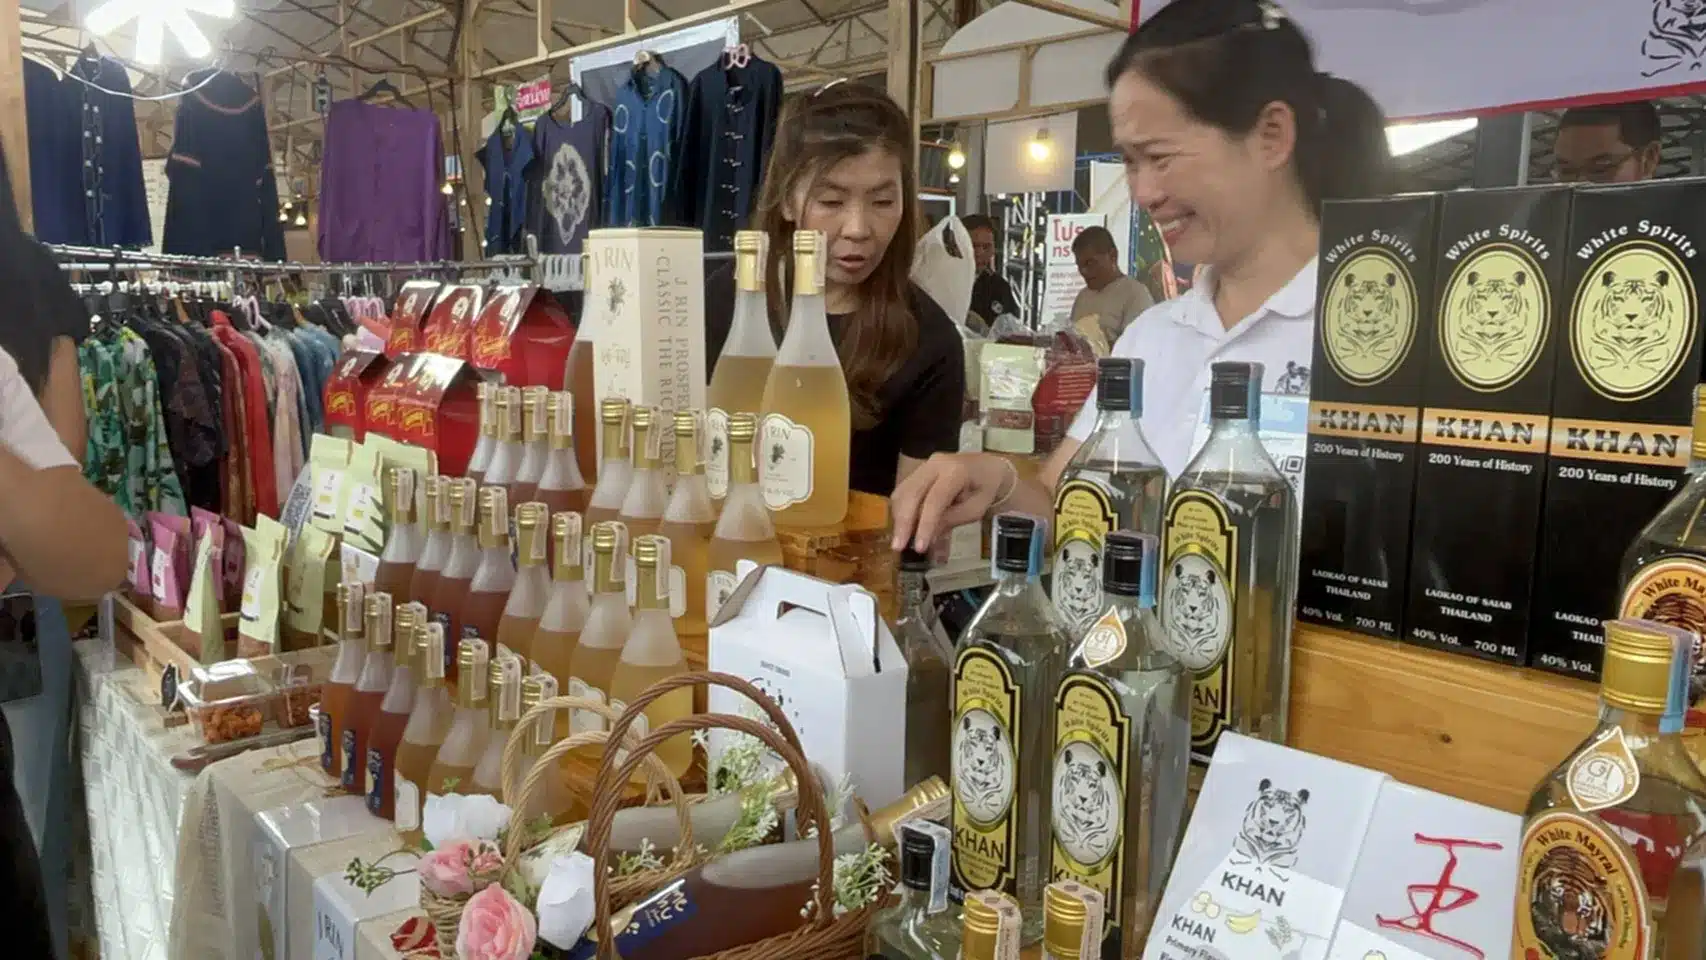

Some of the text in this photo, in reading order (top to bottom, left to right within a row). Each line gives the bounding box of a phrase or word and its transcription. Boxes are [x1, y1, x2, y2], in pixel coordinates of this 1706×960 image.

[1325, 229, 1417, 265] White Spirits
[1445, 224, 1550, 262] White Spirits
[1577, 220, 1698, 261] White Spirits
[656, 255, 671, 329] CLASSIC
[657, 336, 672, 369] THE
[659, 377, 673, 416] RICE
[1319, 408, 1405, 434] KHAN
[1436, 416, 1535, 444] KHAN
[1313, 442, 1404, 462] 200 Years of History
[1566, 428, 1680, 458] KHAN
[1429, 452, 1533, 474] 200 Years of History
[1559, 466, 1678, 490] 200 Years of History
[1312, 569, 1346, 581] LAOKAO
[1348, 575, 1360, 584] OF
[1642, 577, 1680, 598] White
[1325, 585, 1371, 600] THAILAND
[1425, 588, 1464, 602] LAOKAO
[1466, 595, 1480, 605] OF
[1302, 606, 1323, 618] 40%
[1356, 616, 1376, 628] 700
[1440, 605, 1493, 622] THAILAND
[1555, 611, 1599, 626] LAOKAO
[1413, 627, 1437, 640] 40%
[1440, 633, 1461, 646] Vol.
[1474, 639, 1498, 653] 700
[1540, 653, 1595, 674] 40% Vol.
[955, 824, 1004, 861] KHAN
[1536, 828, 1572, 847] White
[1574, 831, 1618, 875] Mayral
[1220, 871, 1285, 907] KHAN
[1171, 913, 1217, 943] KHAN
